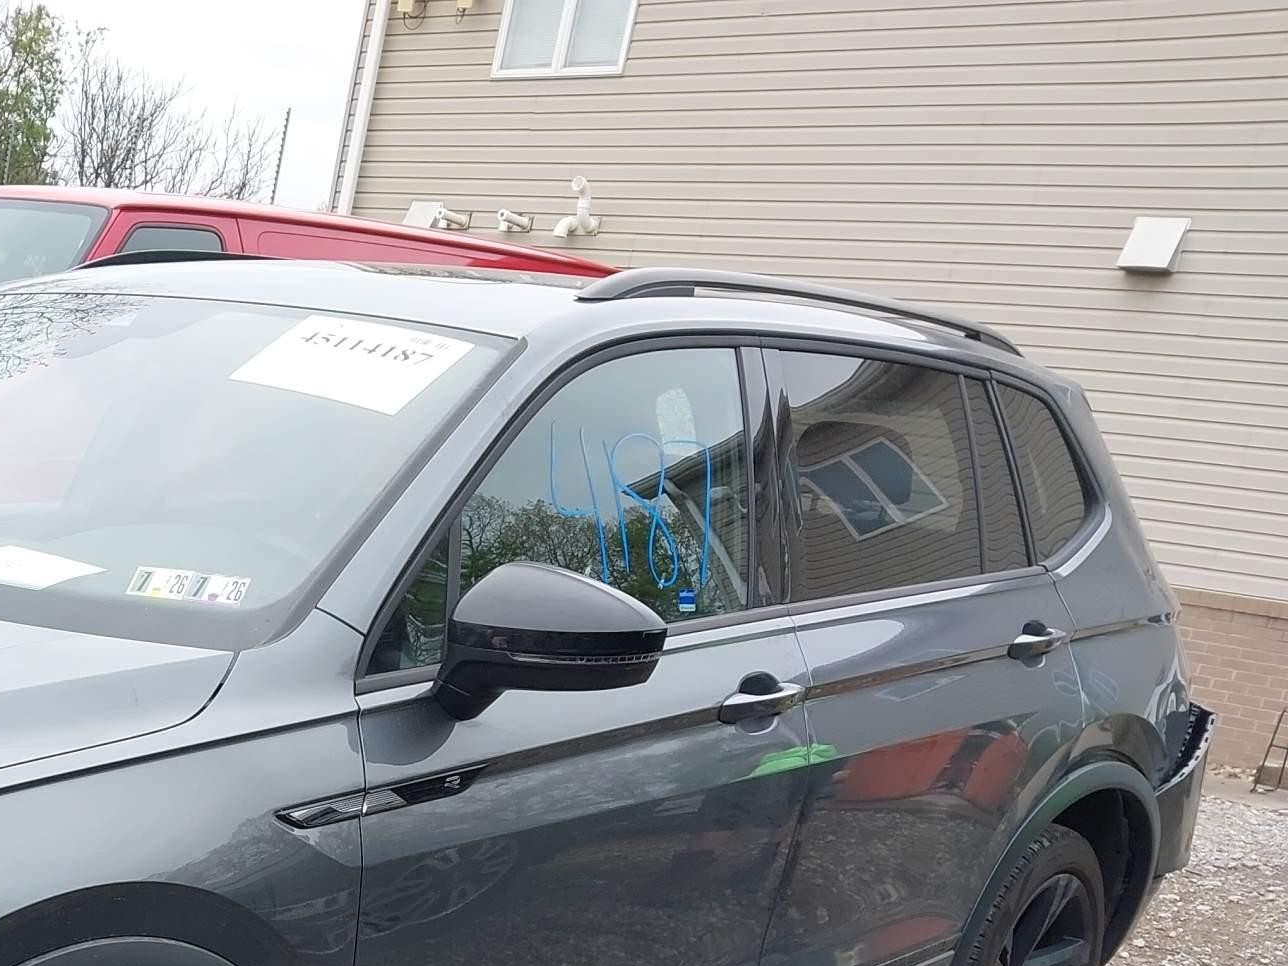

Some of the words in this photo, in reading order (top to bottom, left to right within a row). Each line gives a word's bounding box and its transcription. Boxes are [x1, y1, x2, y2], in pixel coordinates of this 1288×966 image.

[300, 331, 434, 366] 45114187
[168, 574, 189, 595] 26
[225, 580, 247, 602] 26
